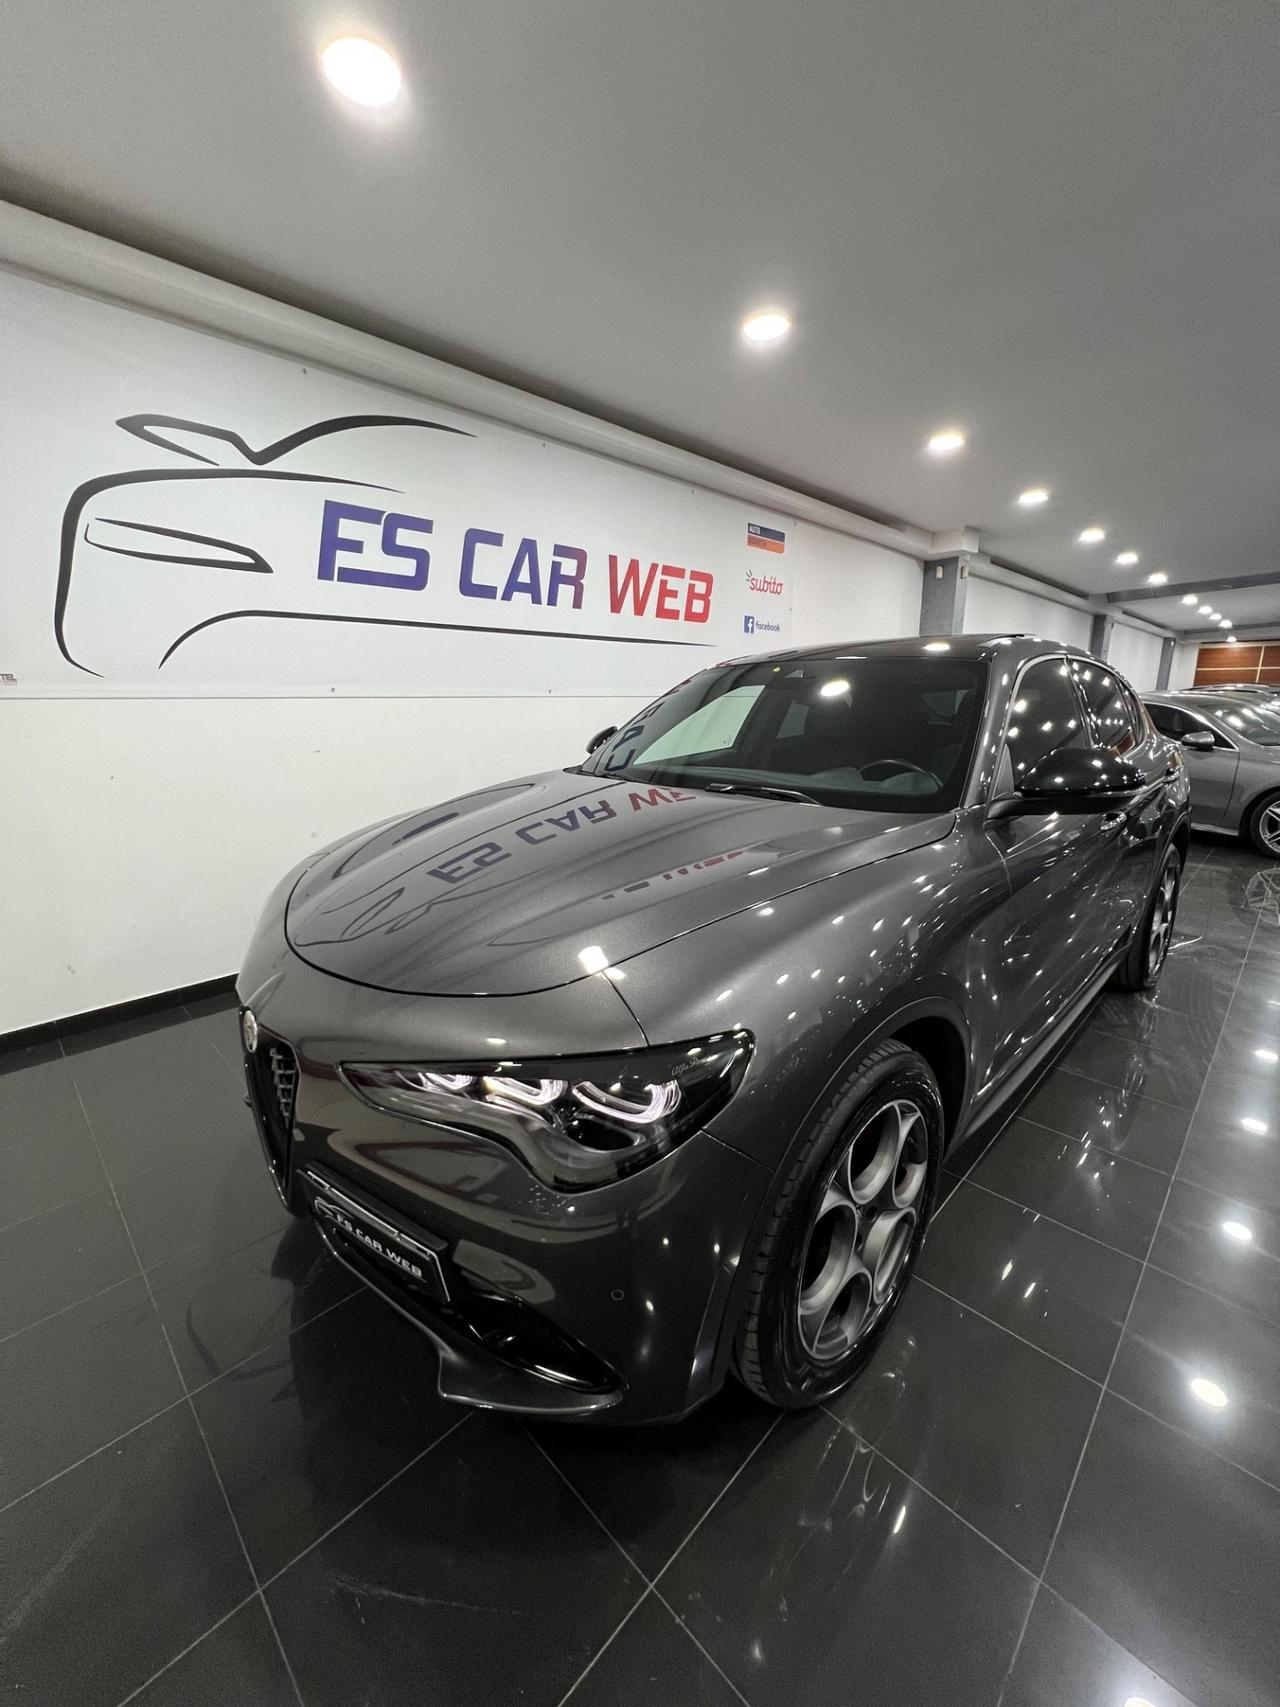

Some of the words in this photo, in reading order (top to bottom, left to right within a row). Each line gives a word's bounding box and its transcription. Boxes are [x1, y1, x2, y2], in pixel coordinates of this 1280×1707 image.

[317, 500, 434, 591] ES
[459, 528, 587, 610] CAR
[608, 554, 714, 623] WEB
[749, 575, 783, 595] subito
[755, 620, 781, 632] facebook
[336, 1214, 353, 1232] ES
[356, 1228, 383, 1252] CAR
[386, 1248, 422, 1277] WEB
